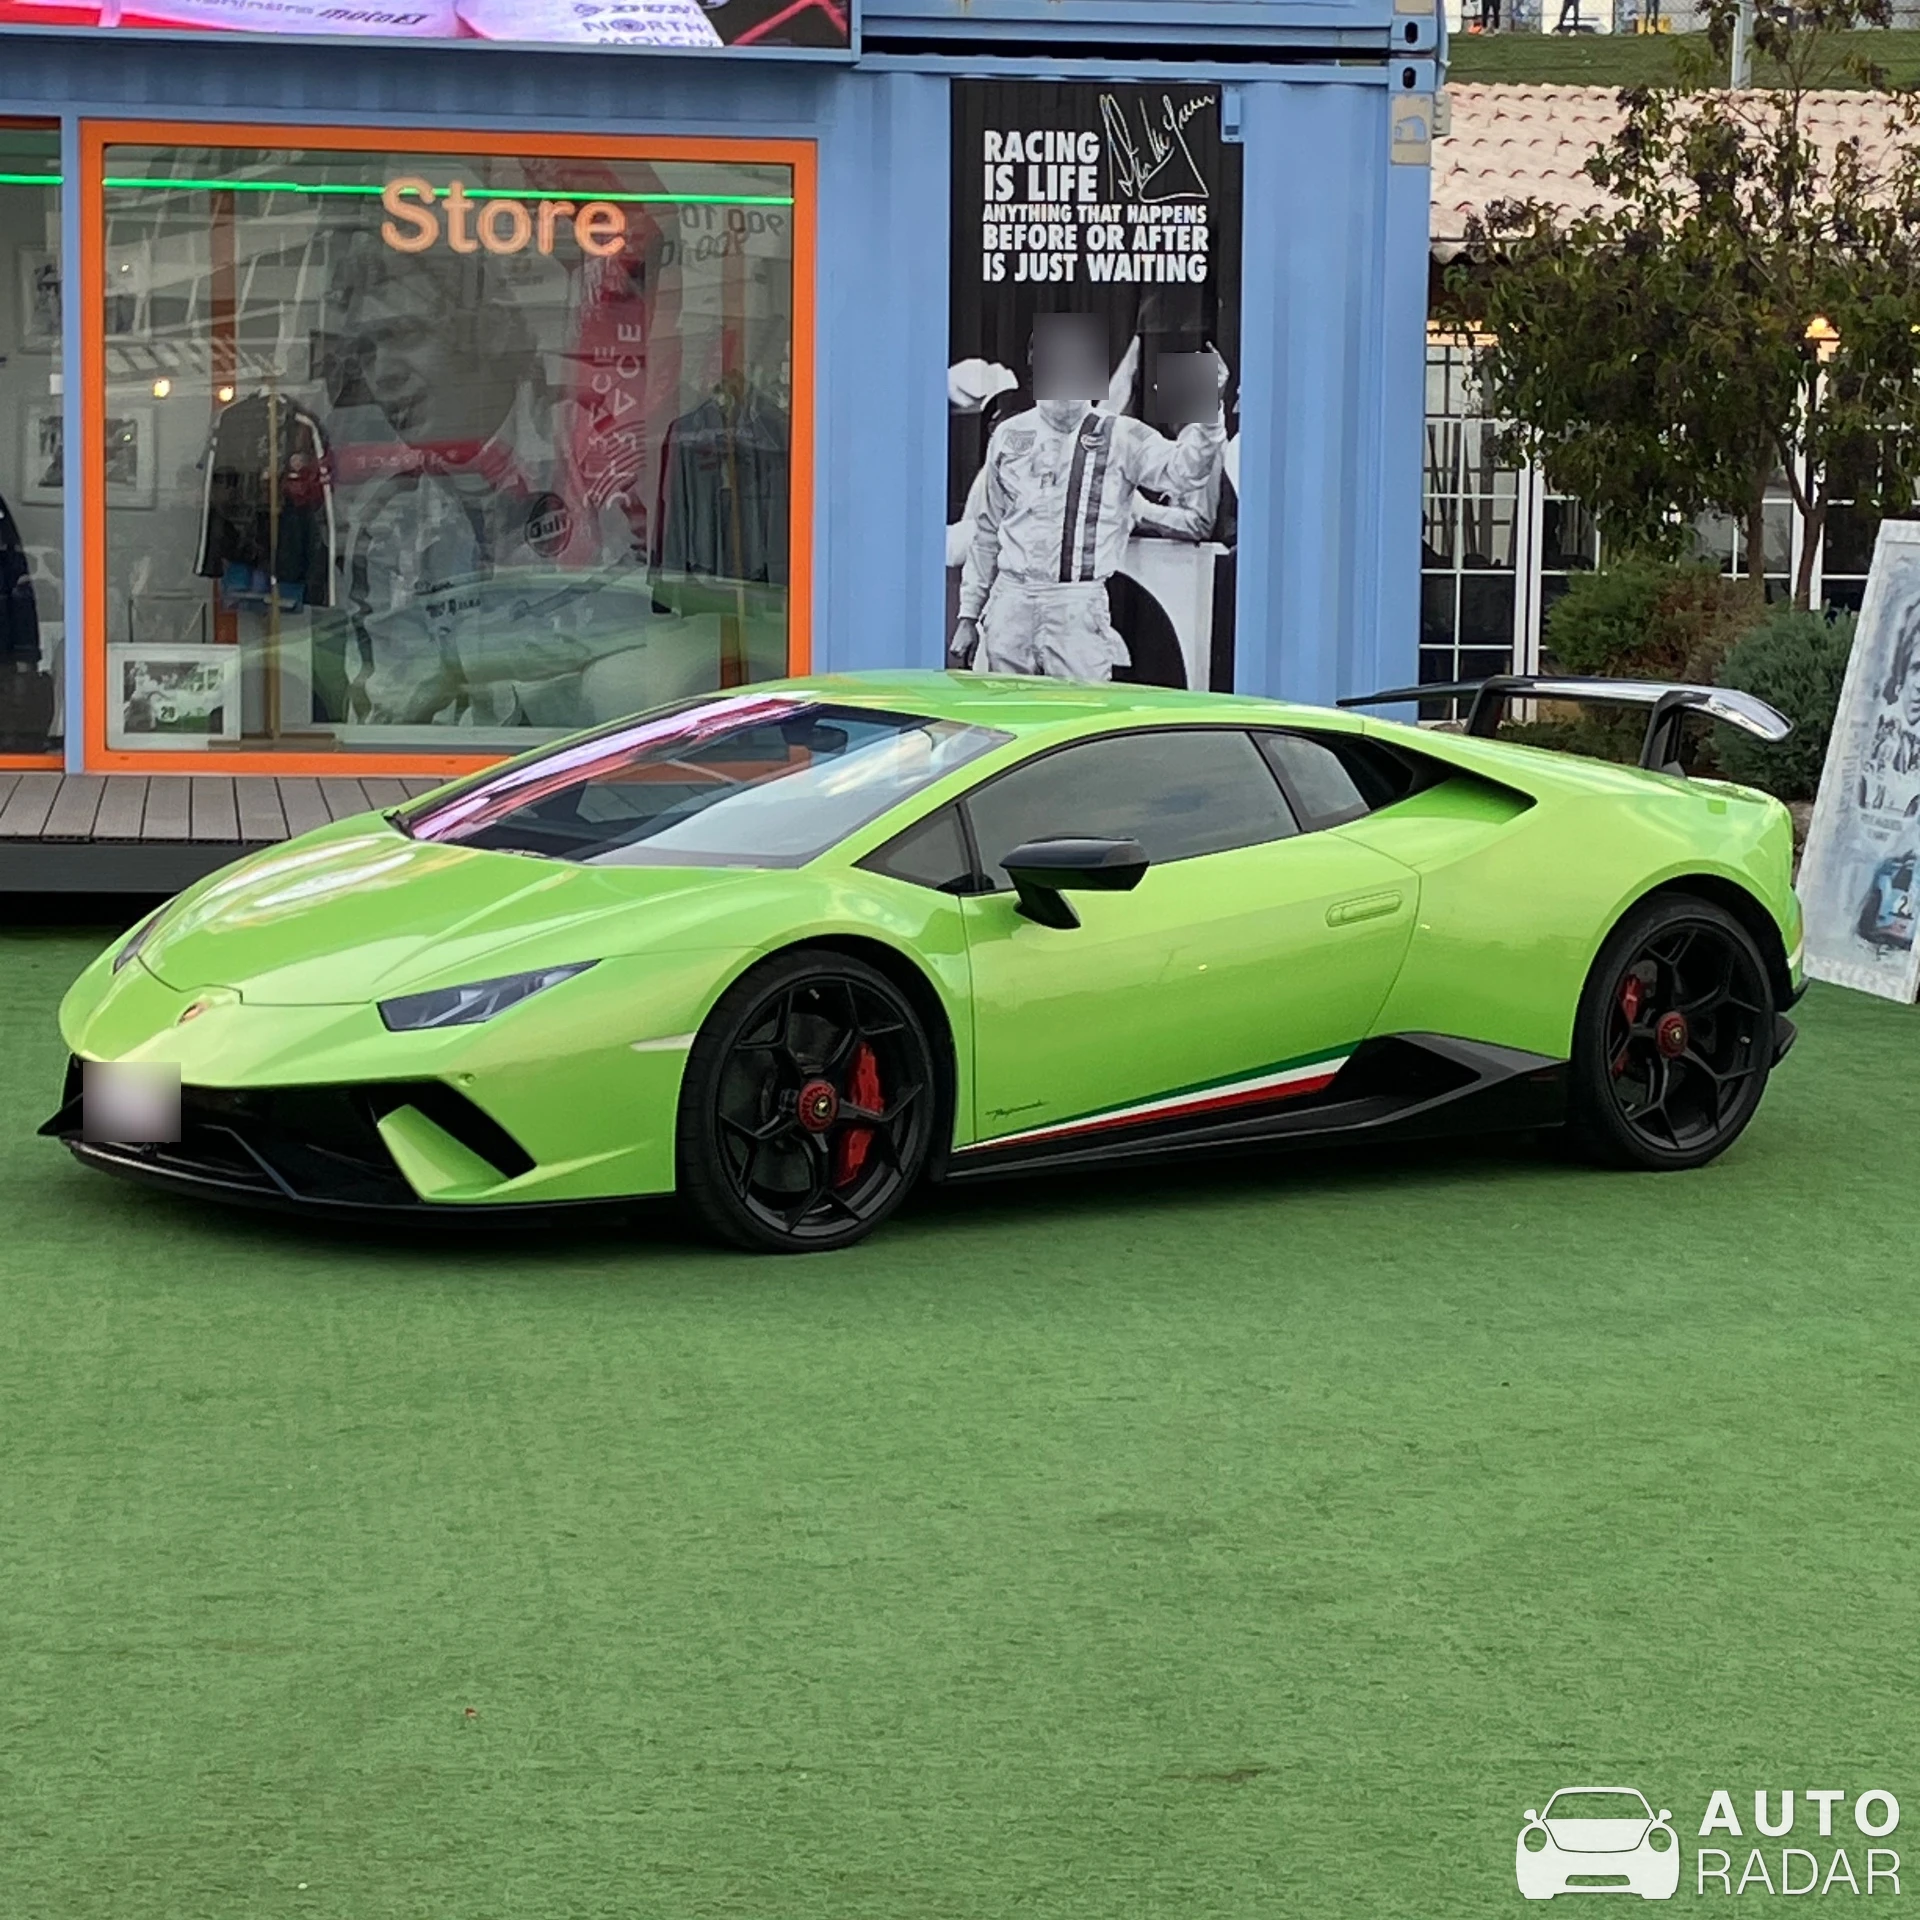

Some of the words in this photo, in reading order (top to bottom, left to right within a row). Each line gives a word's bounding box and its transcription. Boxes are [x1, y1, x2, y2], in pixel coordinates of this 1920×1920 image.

[984, 130, 1099, 163] RACING
[984, 165, 1014, 201] IS
[1028, 165, 1098, 201] LIFE
[381, 176, 626, 256] Store
[983, 204, 1072, 223] ANYTHING
[1077, 204, 1121, 223] THAT
[1127, 205, 1207, 223] HAPPENS
[983, 225, 1077, 250] BEFORE
[1086, 225, 1125, 250] OR
[1132, 226, 1209, 251] AFTER
[983, 253, 1006, 282] IS
[1014, 253, 1078, 282] JUST
[1086, 253, 1208, 283] WAITING
